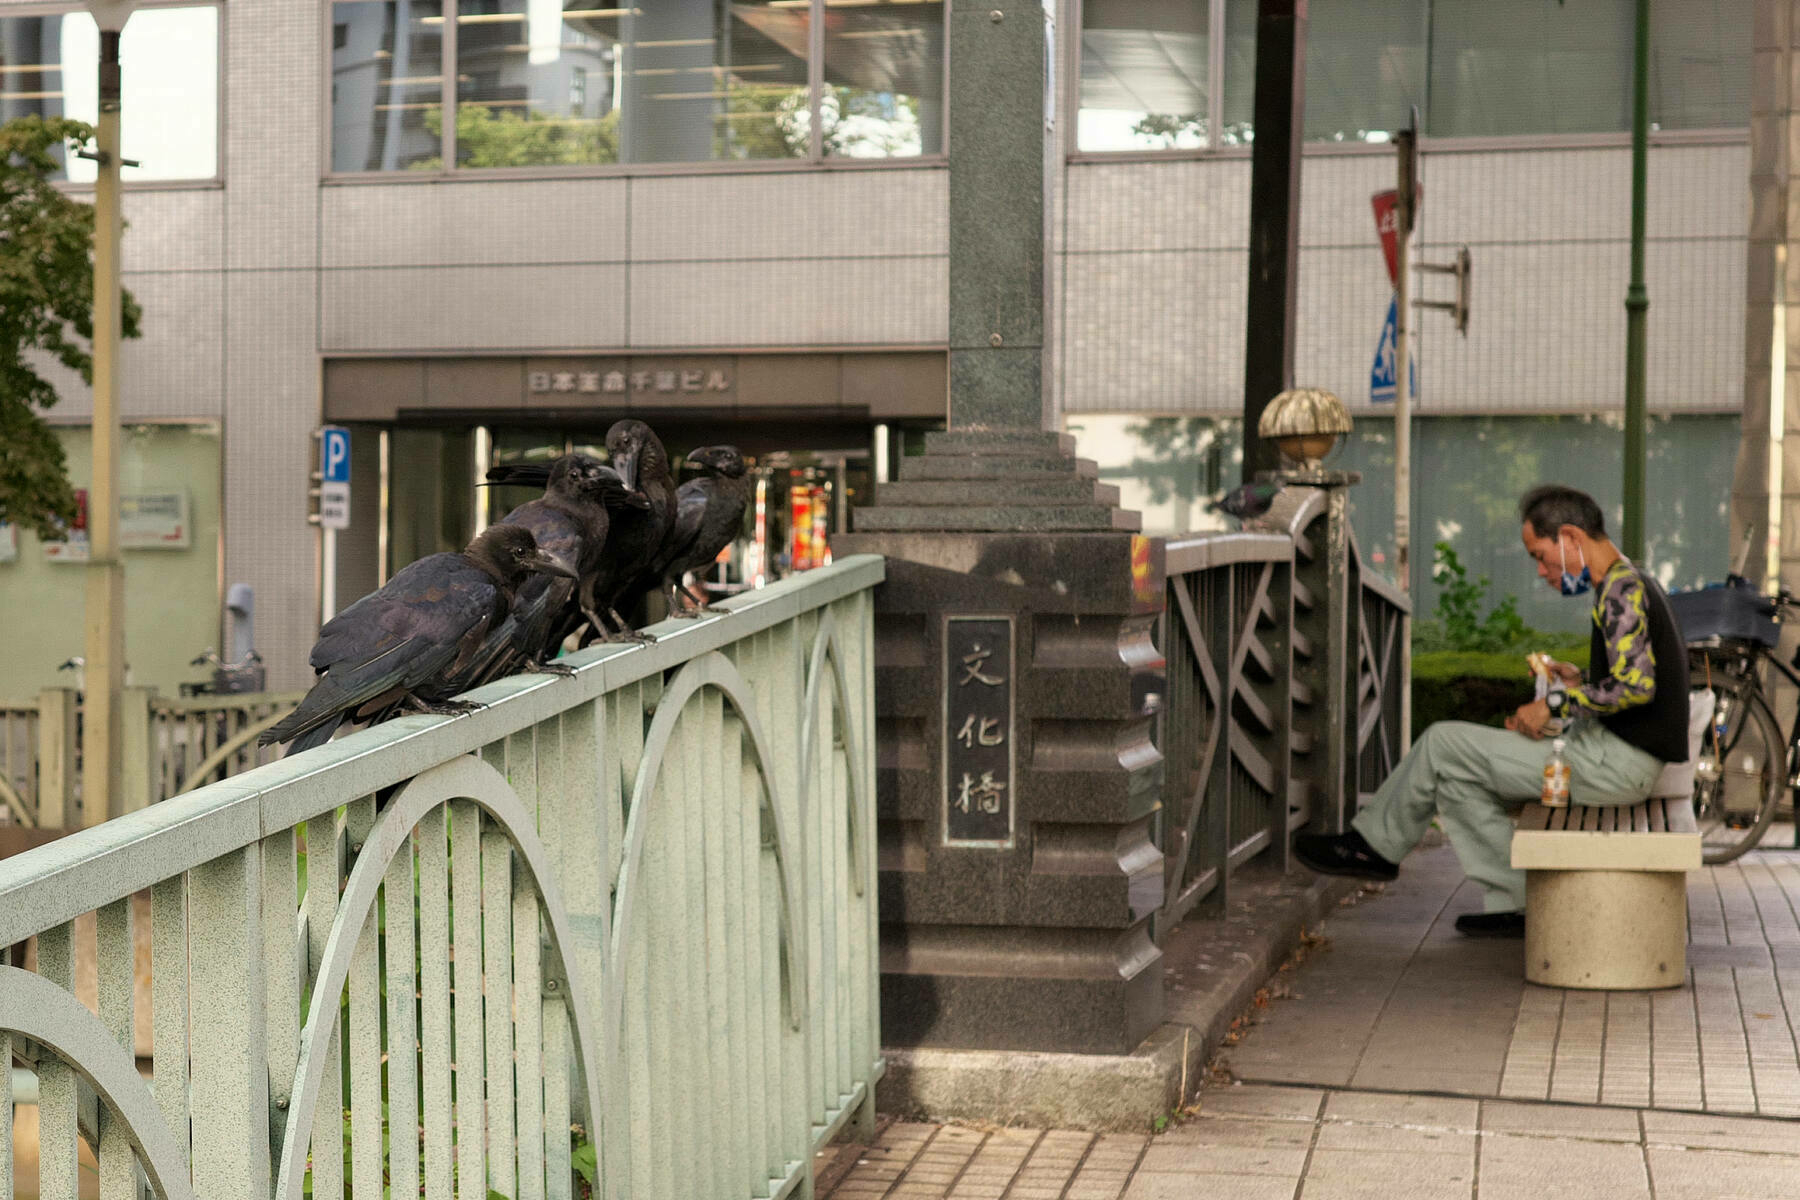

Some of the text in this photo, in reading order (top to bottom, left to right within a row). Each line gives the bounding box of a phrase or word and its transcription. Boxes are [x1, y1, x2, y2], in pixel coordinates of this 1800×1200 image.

[328, 432, 346, 478] P
[954, 641, 1006, 816] 文化橋
